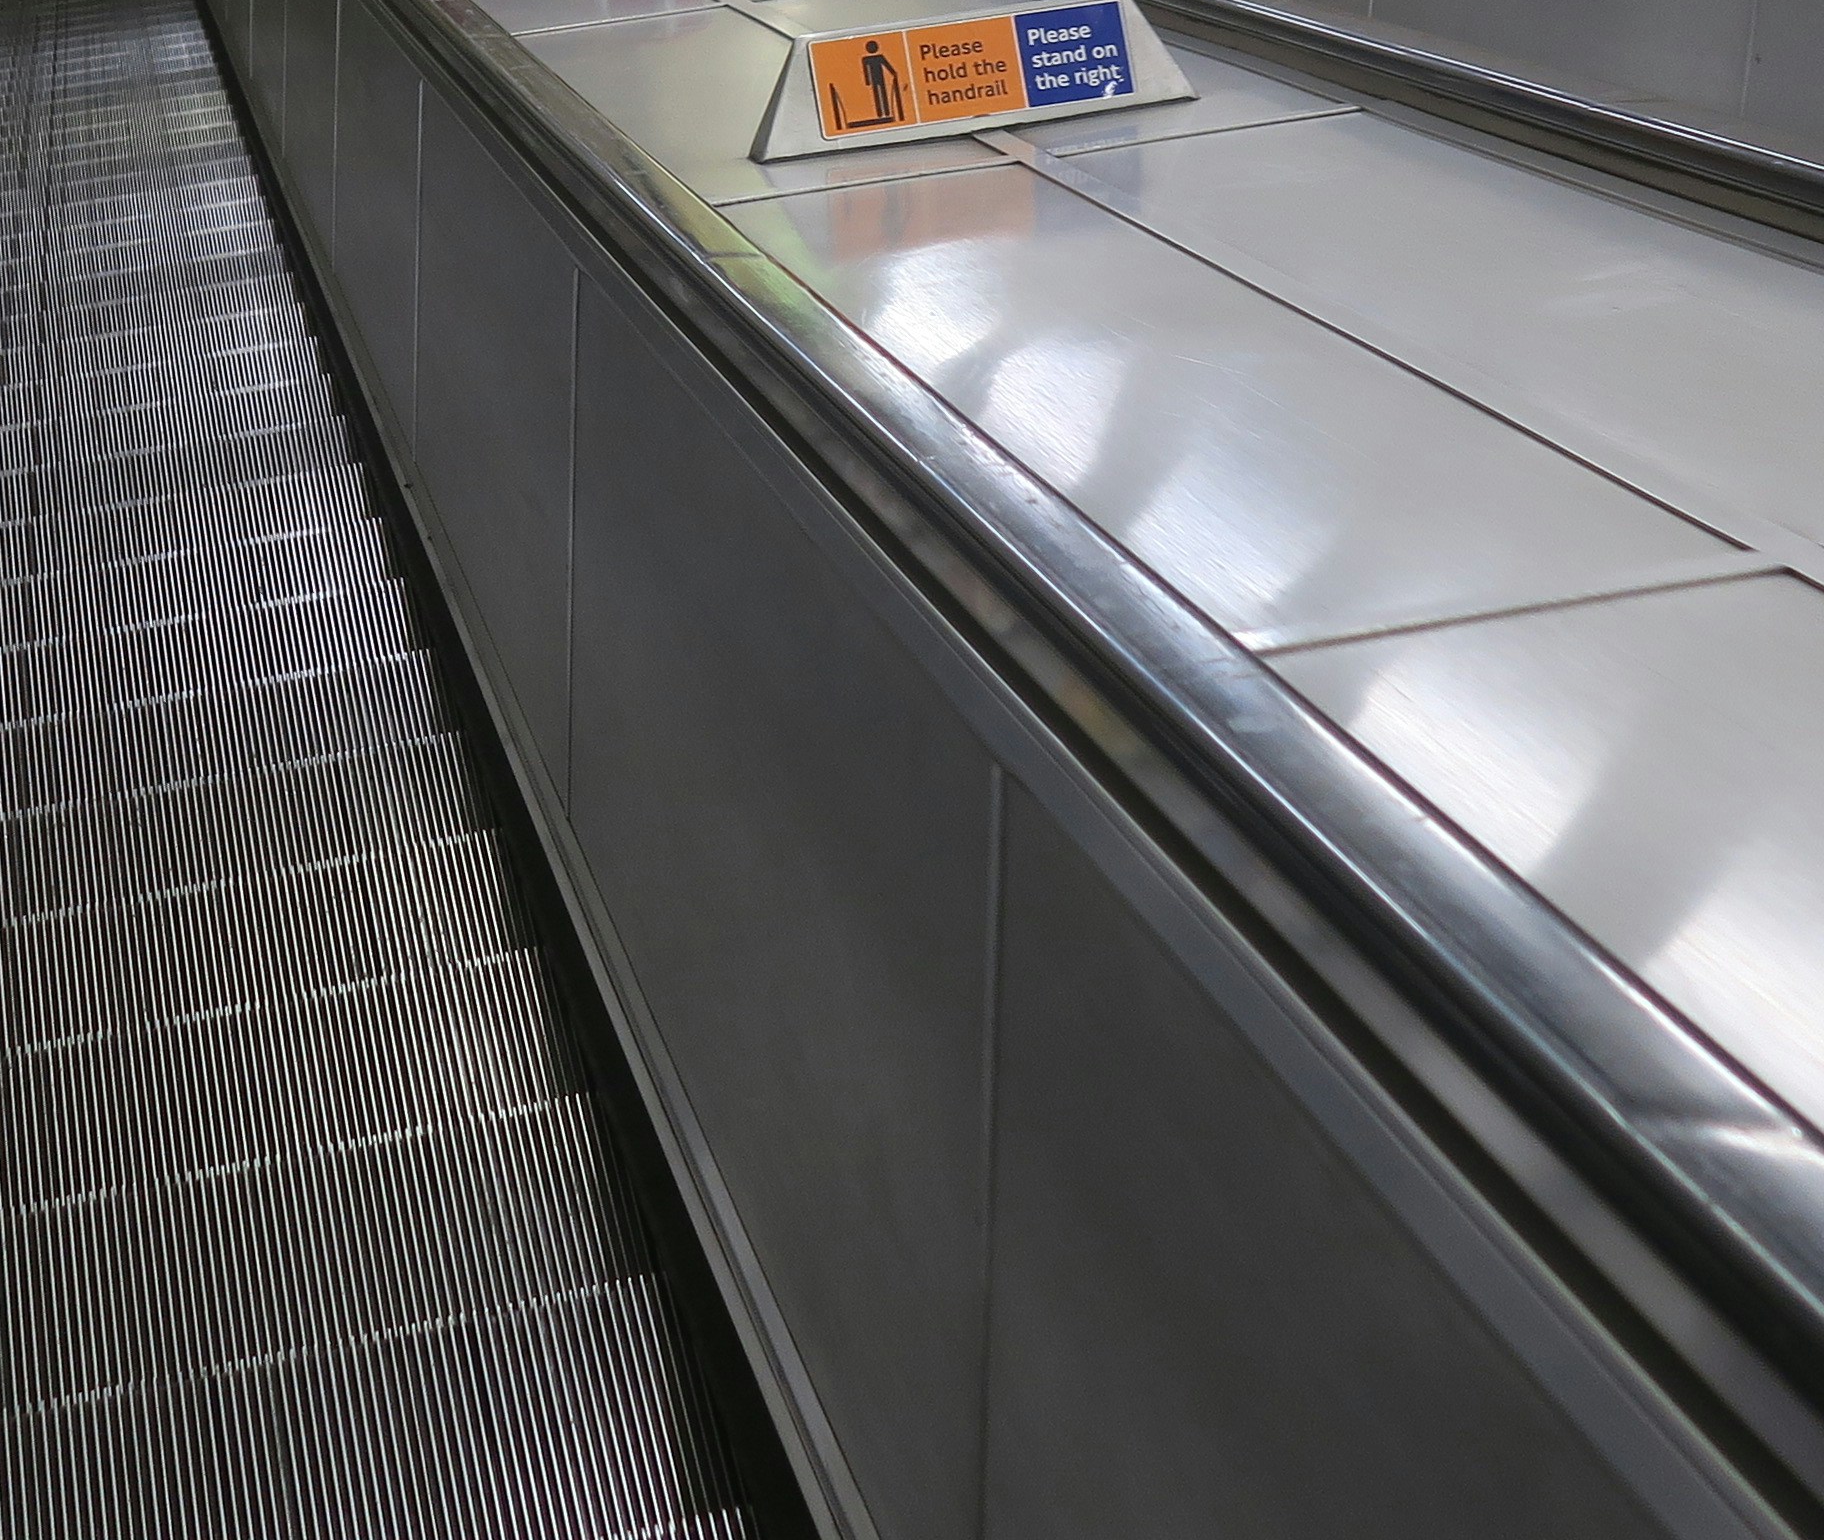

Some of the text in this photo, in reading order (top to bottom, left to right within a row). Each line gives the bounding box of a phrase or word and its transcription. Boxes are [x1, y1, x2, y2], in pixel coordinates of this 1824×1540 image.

[1027, 24, 1091, 46] Please
[920, 40, 983, 60] Please
[1032, 44, 1118, 68] stand on
[925, 58, 1007, 83] hold the
[1035, 64, 1122, 90] the right
[927, 79, 1008, 106] handrail
